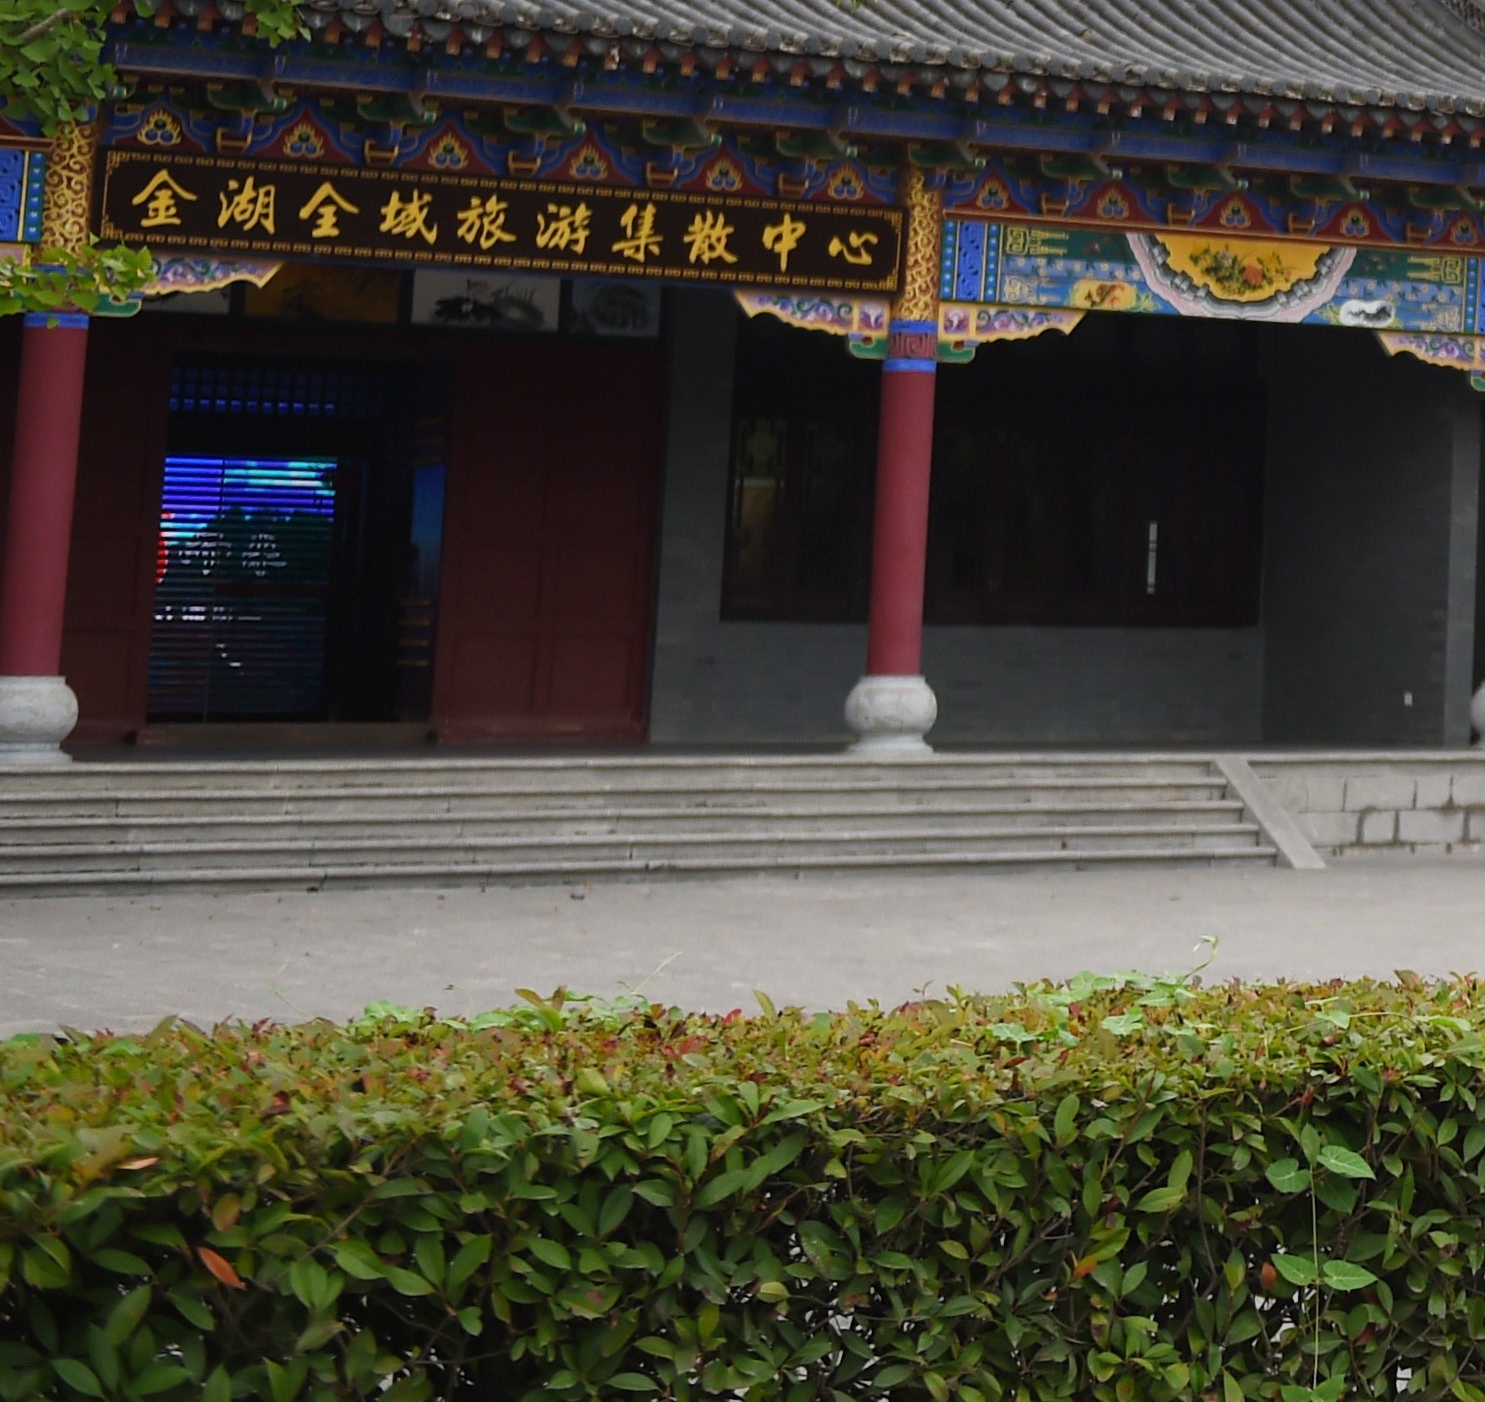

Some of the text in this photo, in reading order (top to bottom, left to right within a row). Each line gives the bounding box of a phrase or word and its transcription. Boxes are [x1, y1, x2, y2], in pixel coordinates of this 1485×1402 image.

[132, 168, 879, 273] 金湖全域旅游集散中心
